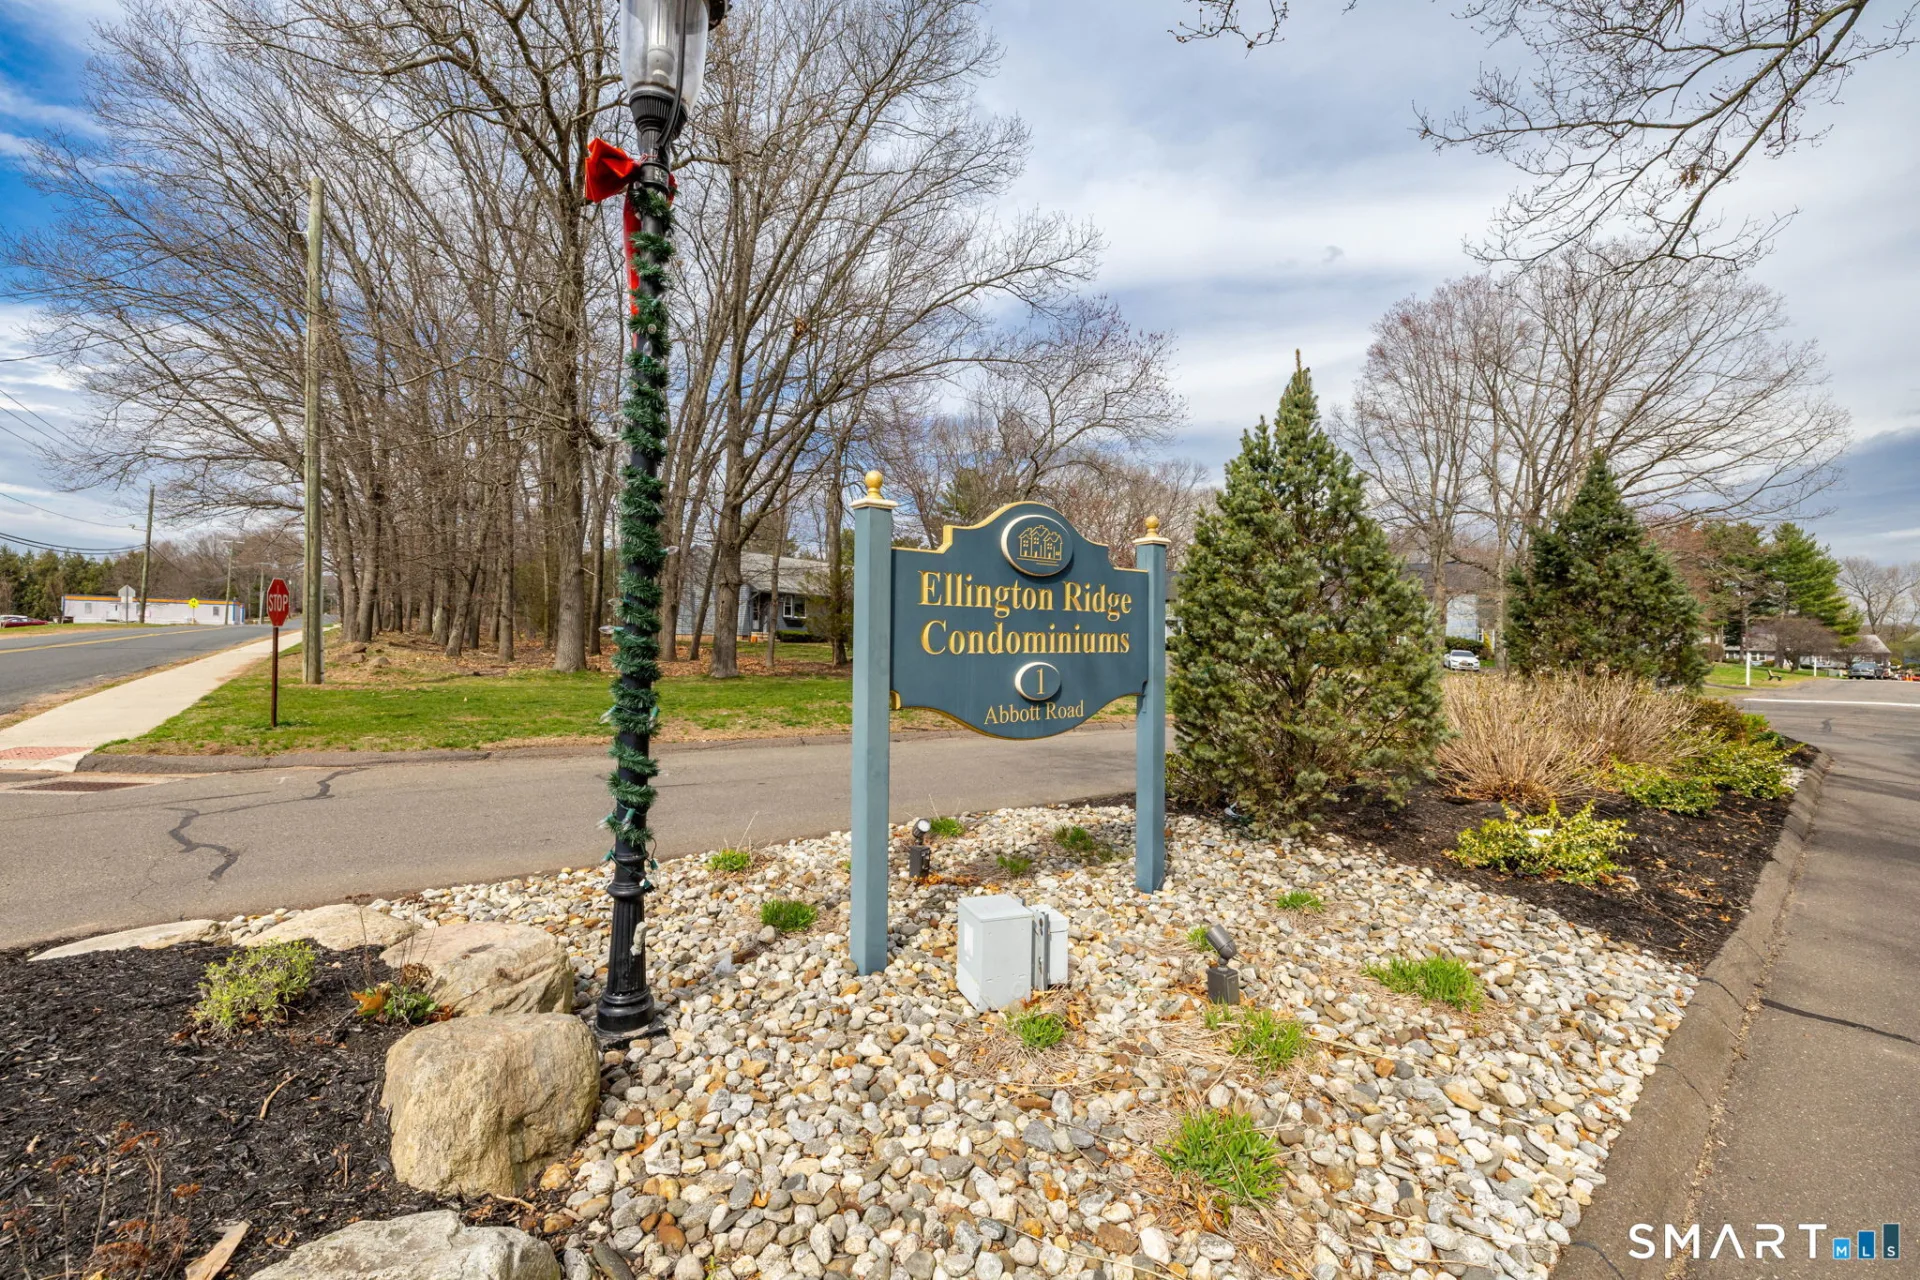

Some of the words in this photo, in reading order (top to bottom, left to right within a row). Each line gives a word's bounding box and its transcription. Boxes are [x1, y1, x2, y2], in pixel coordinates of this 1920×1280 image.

[269, 594, 288, 612] STOP
[917, 570, 1054, 618] Ellington
[1062, 581, 1132, 621] Ridge
[921, 619, 1130, 655] Condominiums
[1036, 668, 1045, 695] 1
[984, 702, 1041, 725] Abbott
[1046, 700, 1084, 719] Road
